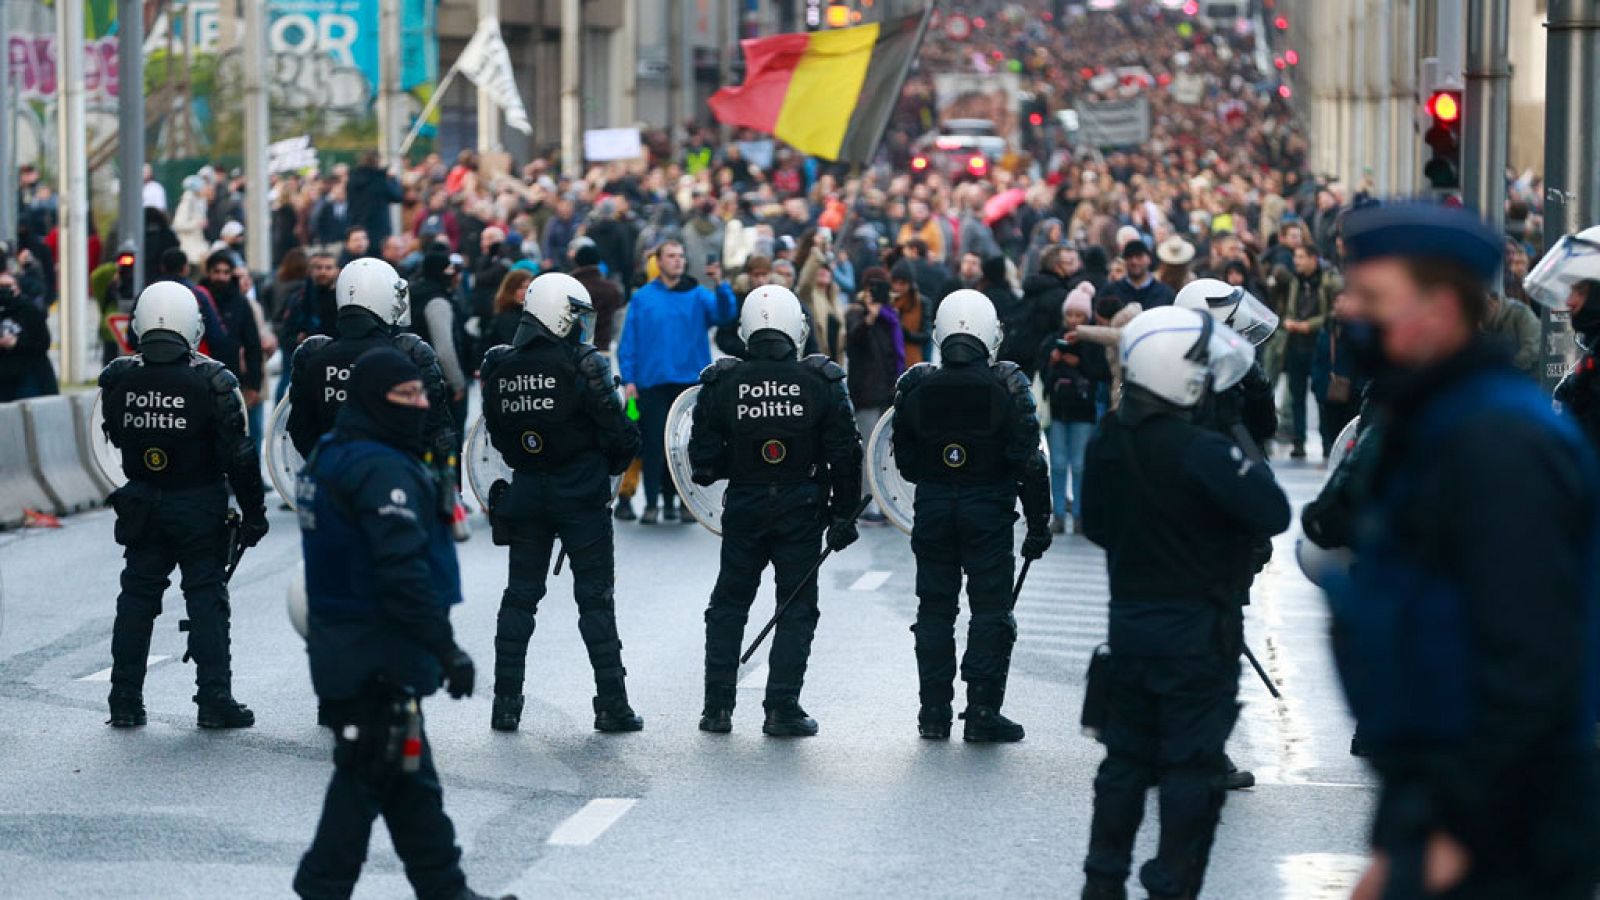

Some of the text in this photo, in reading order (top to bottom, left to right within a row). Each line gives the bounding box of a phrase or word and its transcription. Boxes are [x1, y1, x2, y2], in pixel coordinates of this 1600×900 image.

[499, 374, 556, 393] Politie
[738, 381, 801, 399] Police
[126, 391, 185, 409] Police
[501, 395, 554, 413] Police
[737, 400, 804, 420] Politie
[123, 412, 187, 429] Politie
